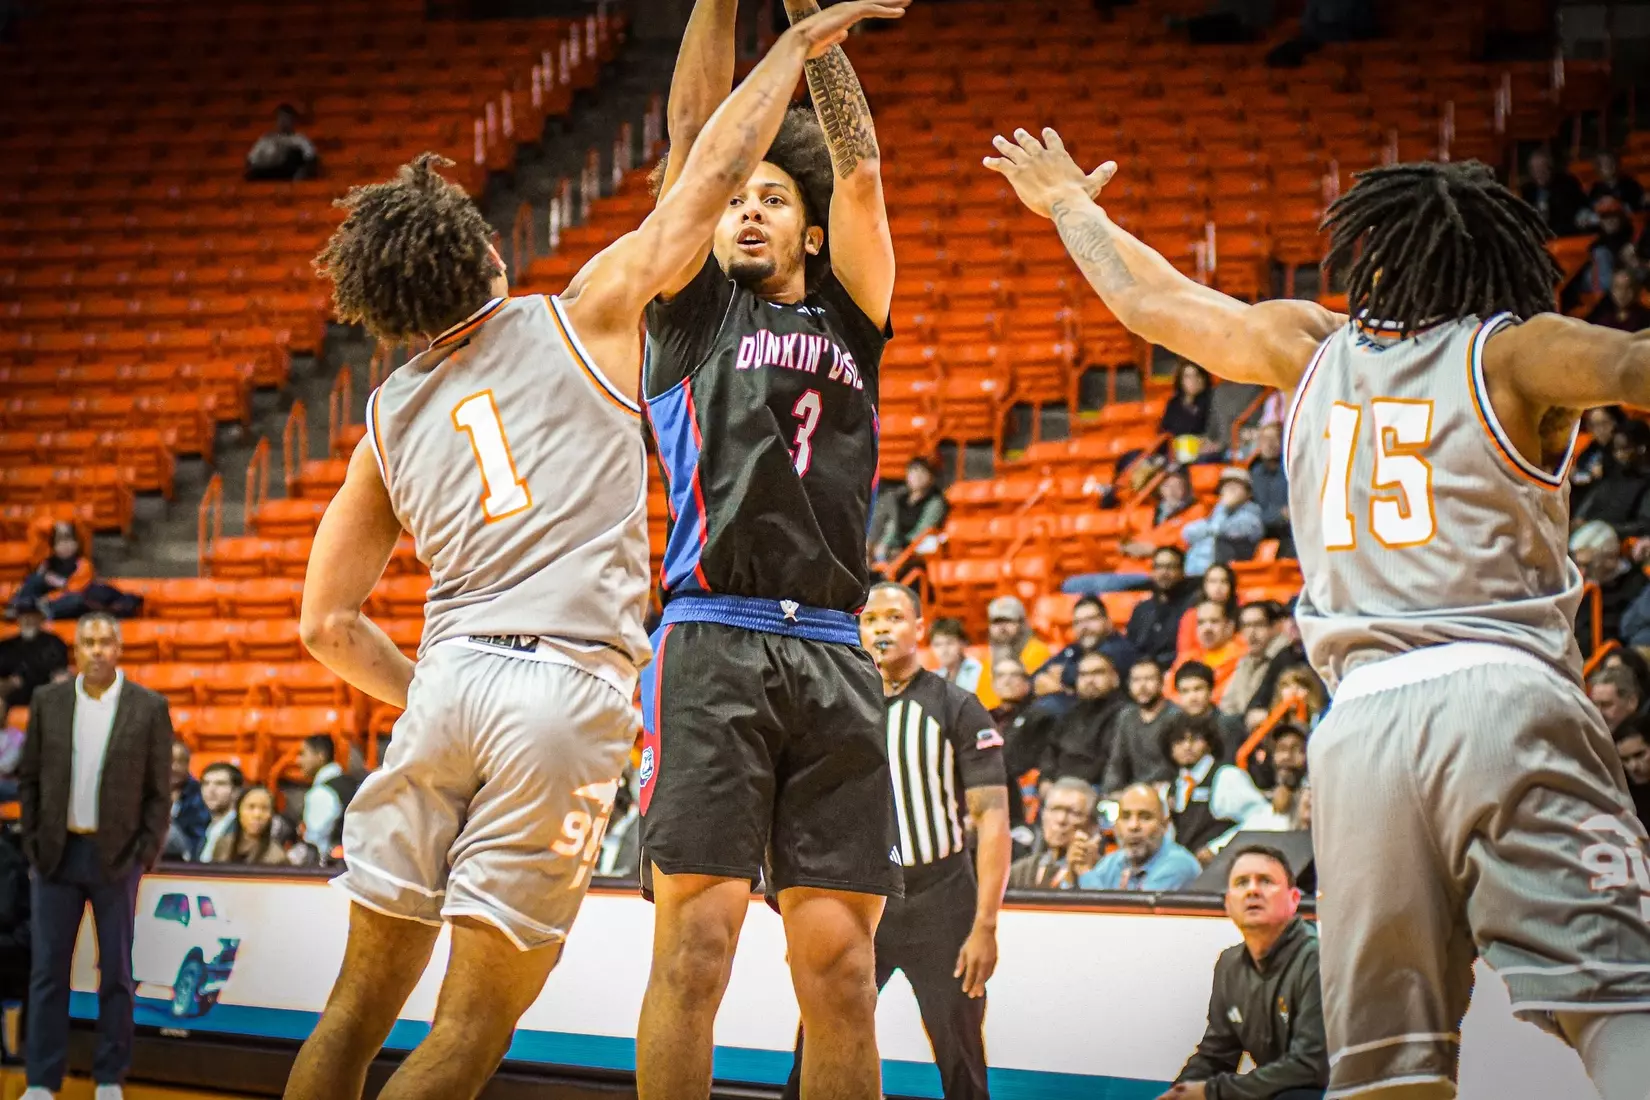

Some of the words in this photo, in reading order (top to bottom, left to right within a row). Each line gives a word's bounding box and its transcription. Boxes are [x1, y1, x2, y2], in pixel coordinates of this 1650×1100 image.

[735, 329, 830, 374] DUNKIN'
[450, 388, 533, 525] 1
[788, 388, 823, 478] 3
[1319, 396, 1438, 552] 15
